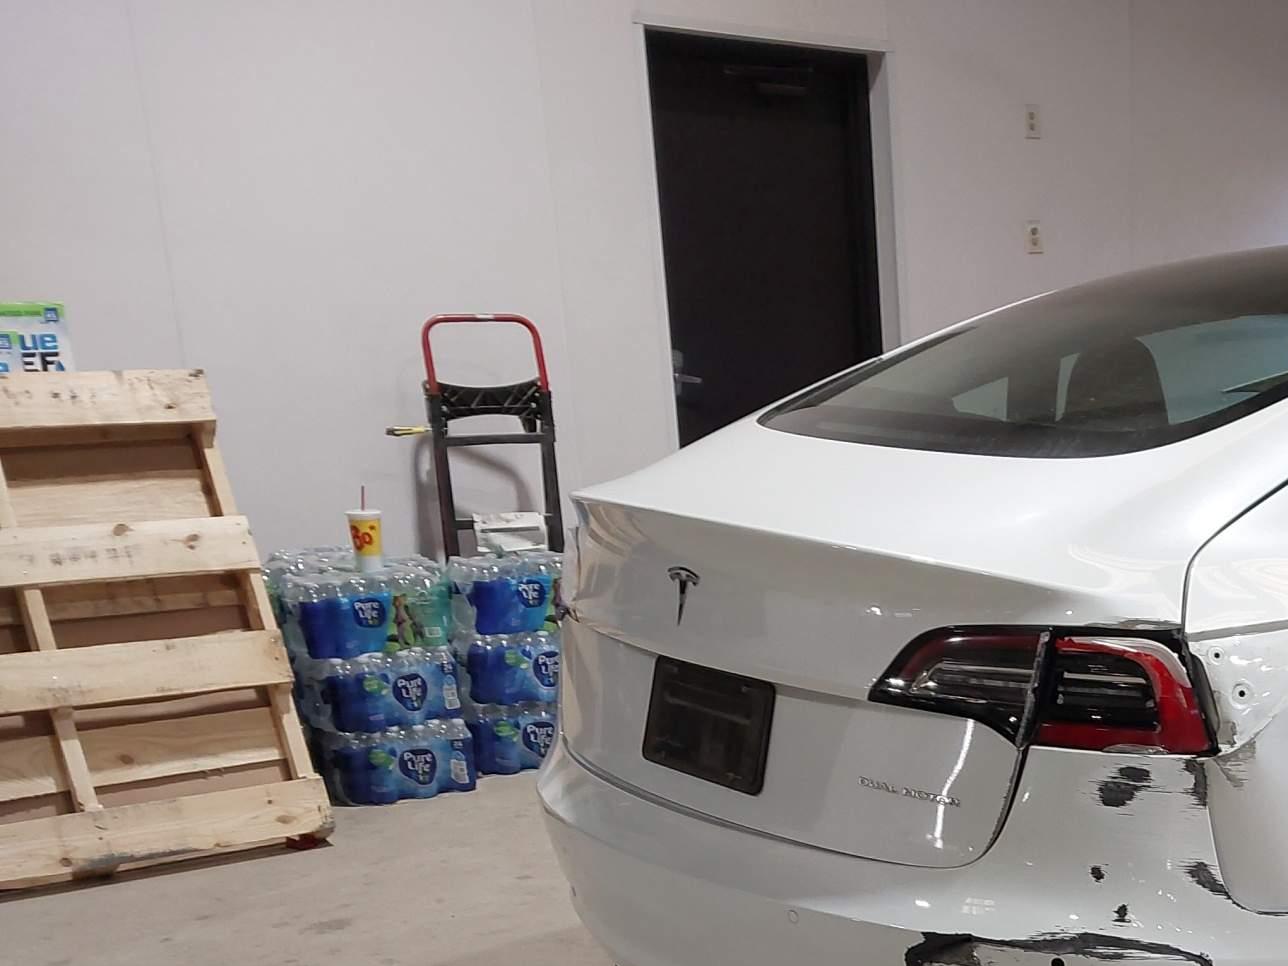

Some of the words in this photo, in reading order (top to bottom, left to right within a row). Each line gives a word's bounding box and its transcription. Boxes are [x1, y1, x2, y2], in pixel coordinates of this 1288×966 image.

[403, 752, 432, 761] Pure
[407, 761, 431, 773] Life
[858, 776, 898, 794] DUAL
[902, 787, 961, 807] MOTOR
